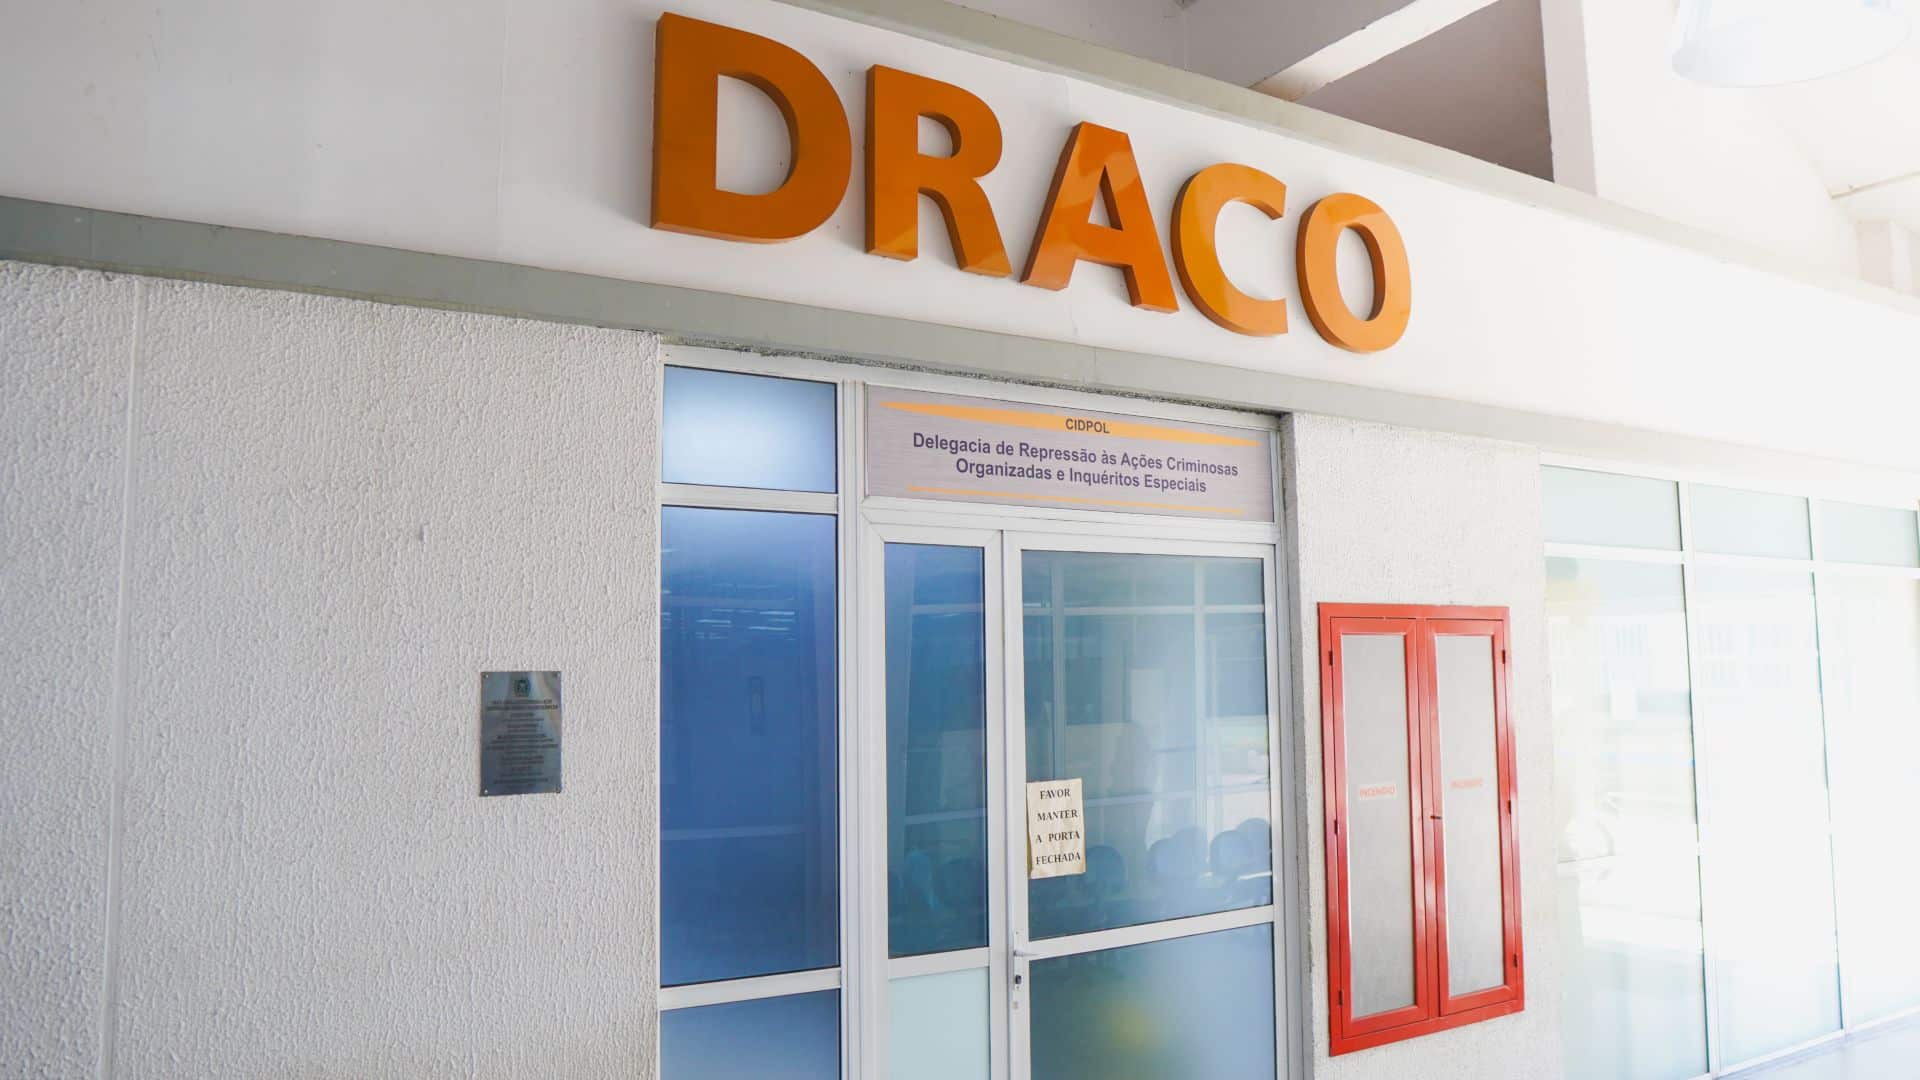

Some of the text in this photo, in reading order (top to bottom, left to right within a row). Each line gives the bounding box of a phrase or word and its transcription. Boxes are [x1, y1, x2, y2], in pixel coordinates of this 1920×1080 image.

[651, 12, 1412, 354] DRACO
[1065, 418, 1110, 434] CIDPOL
[913, 432, 1238, 476] Delegacia de Repressão às Ações Criminosas
[956, 458, 1207, 492] Organizadas e Inquéritos Especiais
[1040, 788, 1070, 800] FAVOR
[1037, 809, 1078, 820] MANTER
[1036, 831, 1080, 843] A PORTA
[1036, 852, 1081, 864] FECHADA
